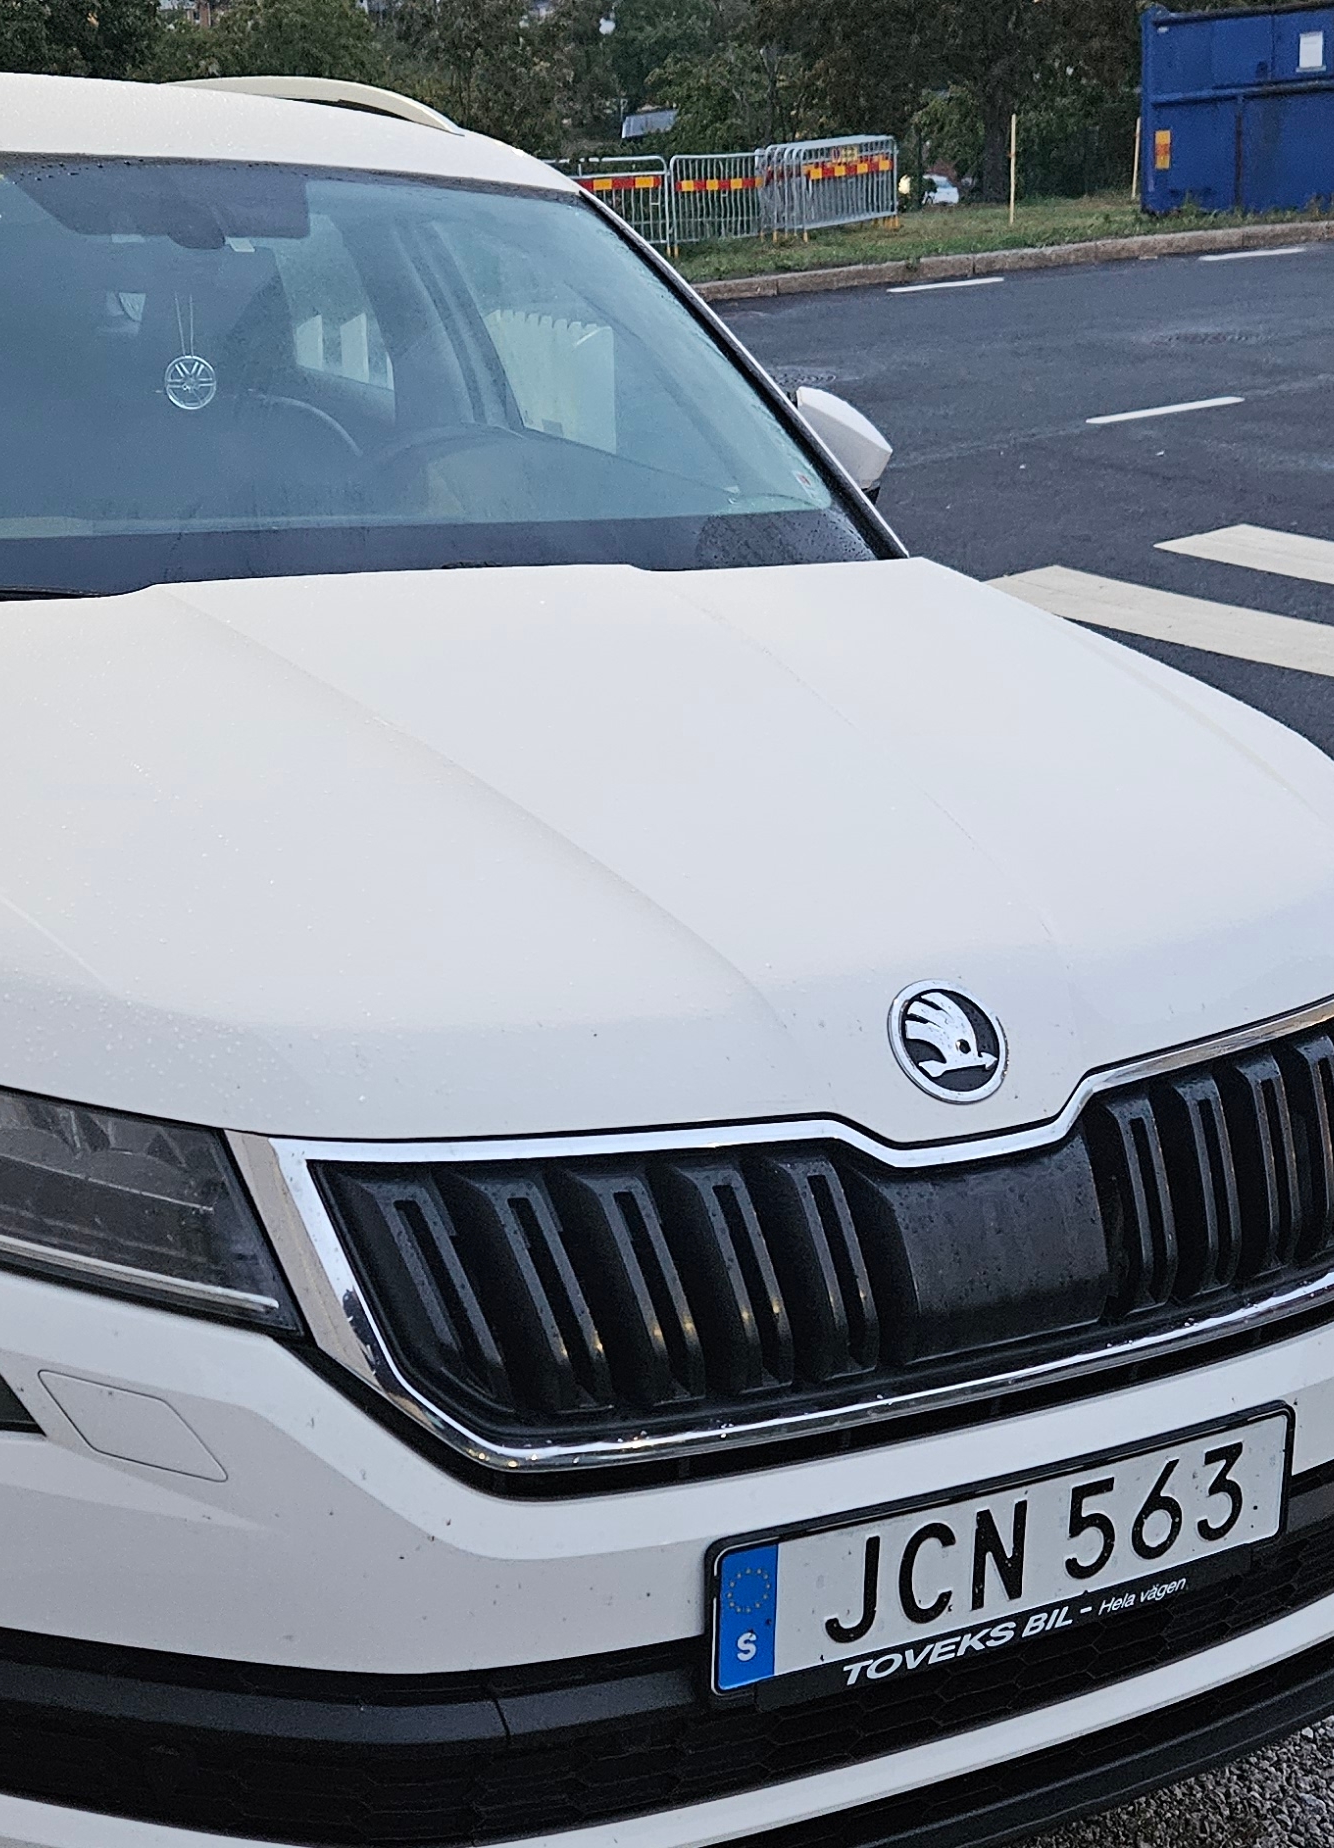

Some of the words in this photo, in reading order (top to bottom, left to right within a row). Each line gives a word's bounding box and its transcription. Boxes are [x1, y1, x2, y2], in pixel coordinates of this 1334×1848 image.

[824, 1500, 1028, 1643] JCN
[1065, 1442, 1244, 1579] 563
[736, 1631, 756, 1661] S
[843, 1622, 1016, 1686] TOVEKS
[1022, 1606, 1073, 1638] BIL
[1098, 1594, 1135, 1616] Hela
[1140, 1577, 1186, 1605] vägen
